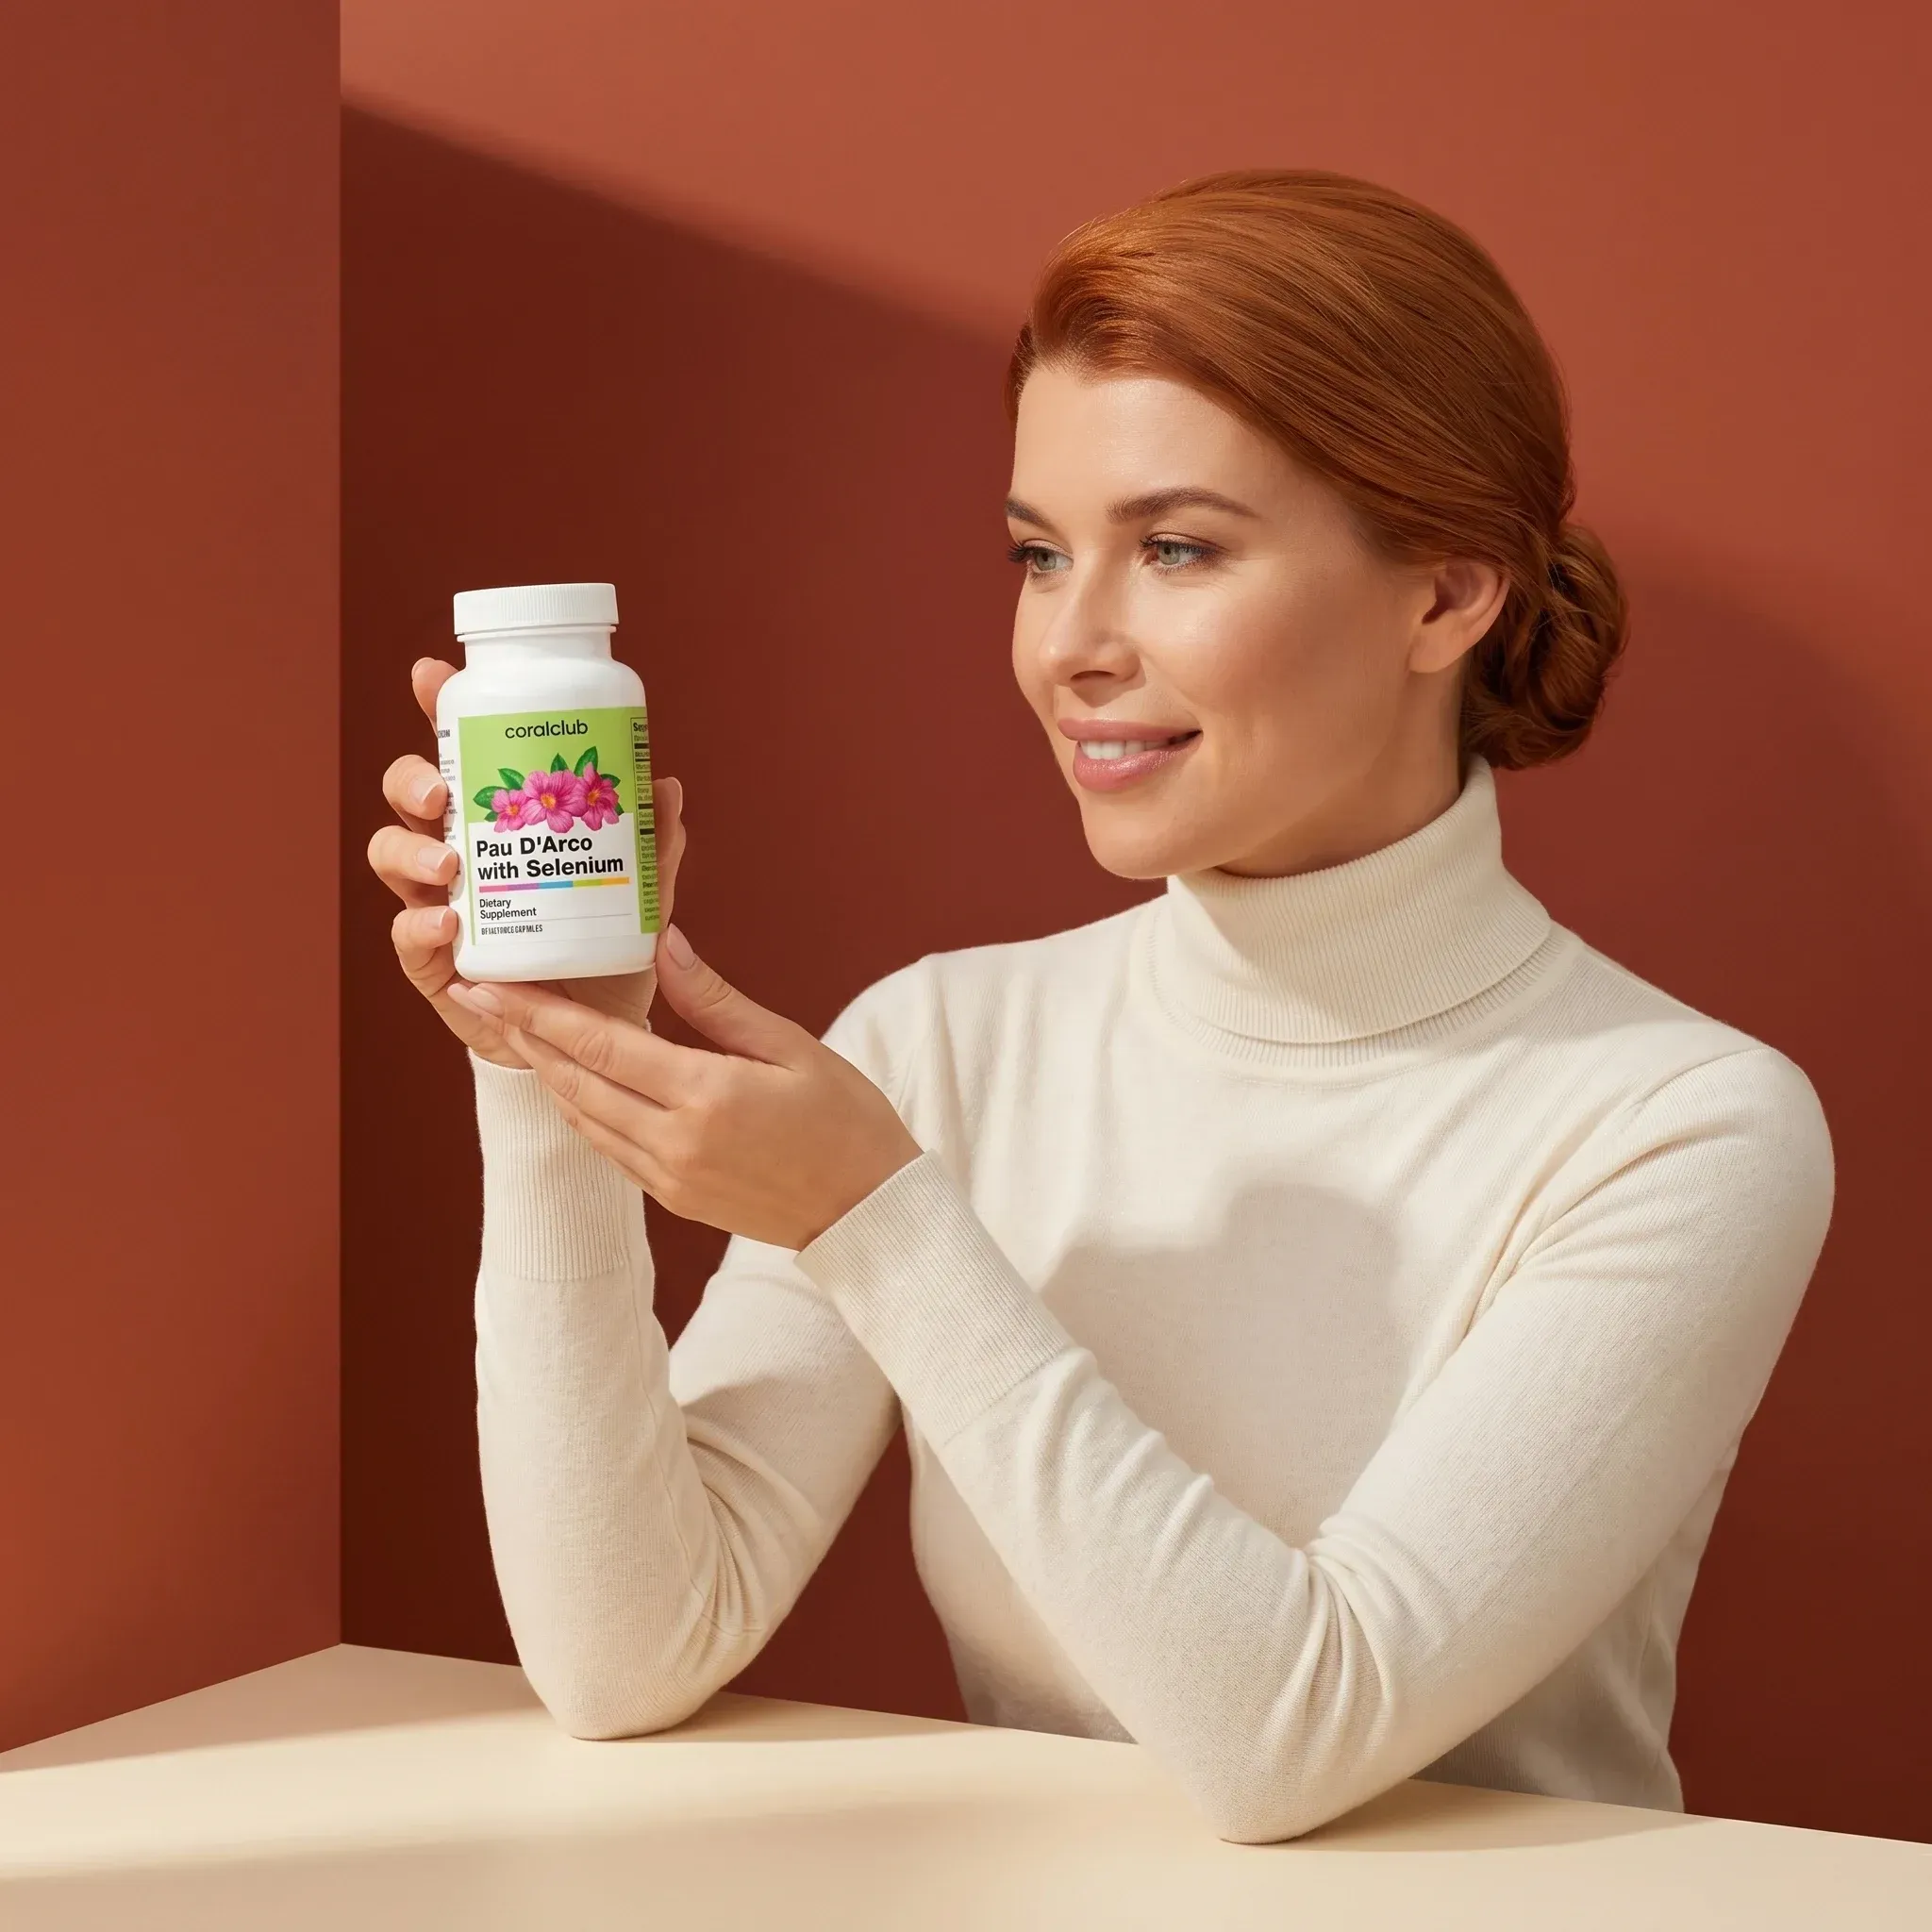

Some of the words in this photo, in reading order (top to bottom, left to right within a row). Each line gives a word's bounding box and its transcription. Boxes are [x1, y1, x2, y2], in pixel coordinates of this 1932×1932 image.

[505, 719, 589, 739] coralclub
[476, 840, 512, 858] Pau
[520, 836, 592, 855] D'Arco
[477, 862, 519, 880] with
[526, 857, 624, 877] Selenium
[479, 898, 511, 908] Dietary
[480, 908, 537, 921] Supplement
